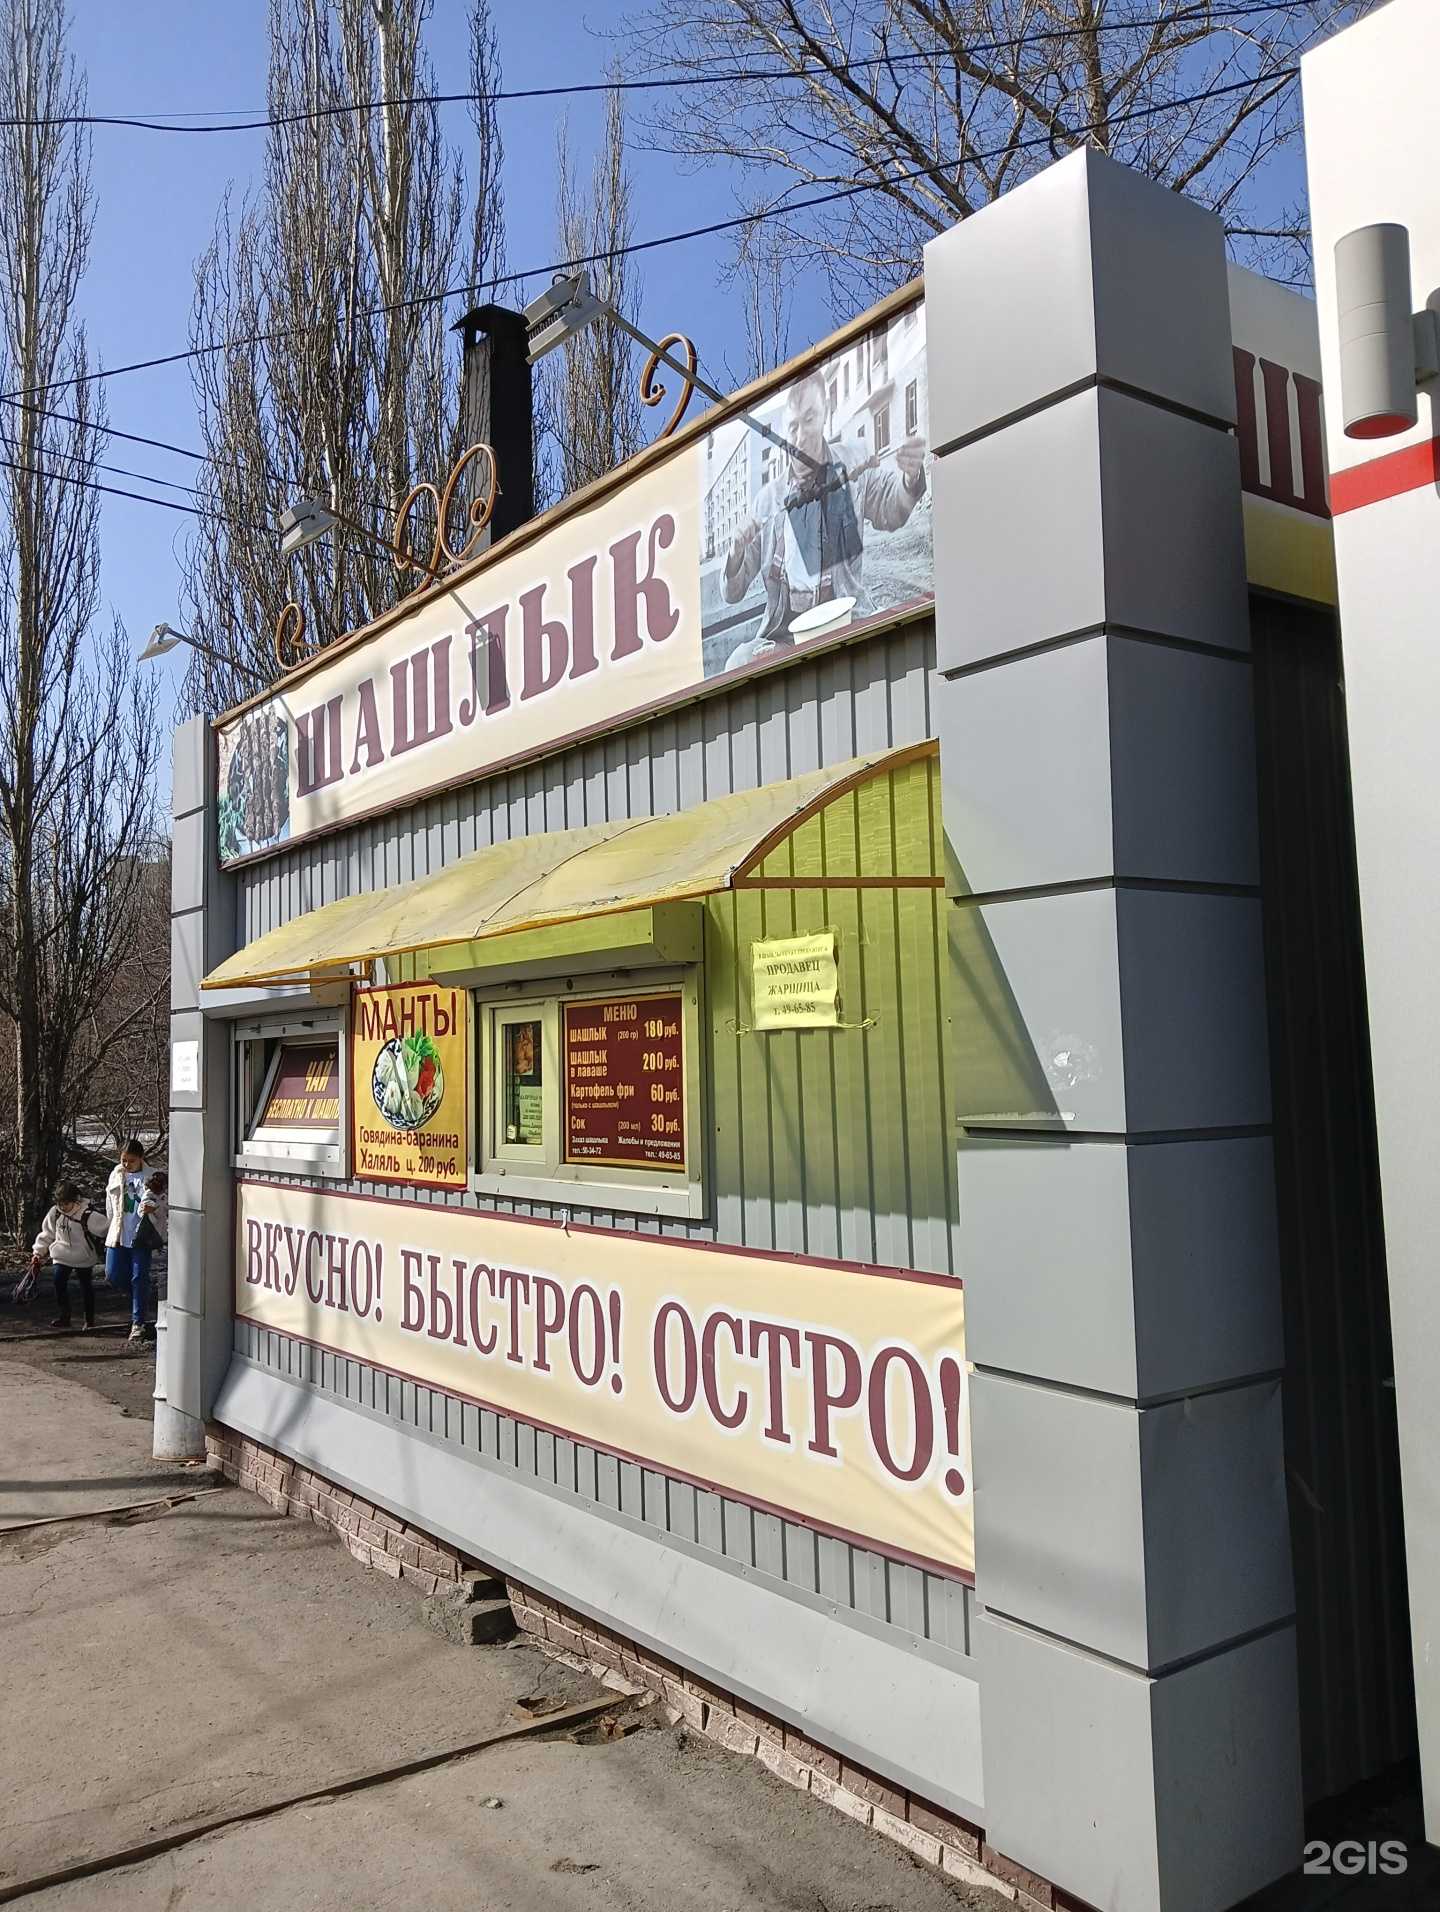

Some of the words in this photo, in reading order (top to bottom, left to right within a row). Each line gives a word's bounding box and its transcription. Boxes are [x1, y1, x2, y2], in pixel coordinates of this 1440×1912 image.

[295, 513, 680, 798] ШАШЛЫК
[766, 959, 821, 976] ПРОДАВЕЦ
[361, 992, 457, 1041] МАНТЫ
[603, 1004, 637, 1022] МЕНЮ
[570, 1027, 607, 1042] ШАШЛЫК
[644, 1020, 663, 1038] 180
[664, 1023, 679, 1038] руб.
[570, 1049, 607, 1065] ШАШЛЫК
[642, 1052, 663, 1070] 200
[664, 1056, 680, 1070] руб.
[577, 1065, 607, 1077] лаваше
[571, 1083, 615, 1100] Картофель
[617, 1083, 634, 1099] фри
[651, 1084, 664, 1102] 60
[665, 1088, 680, 1103] руб.
[571, 1116, 586, 1130] Сок
[651, 1113, 664, 1132] 30
[665, 1119, 680, 1133] руб.
[359, 1125, 459, 1149] Говядина-баранина
[360, 1148, 400, 1172] Халяль
[418, 1156, 435, 1173] 200
[436, 1158, 459, 1178] руб.
[246, 1218, 383, 1323] ВКУСНО!
[400, 1249, 622, 1394] БЫСТРО!
[653, 1301, 965, 1496] ОСТРО!
